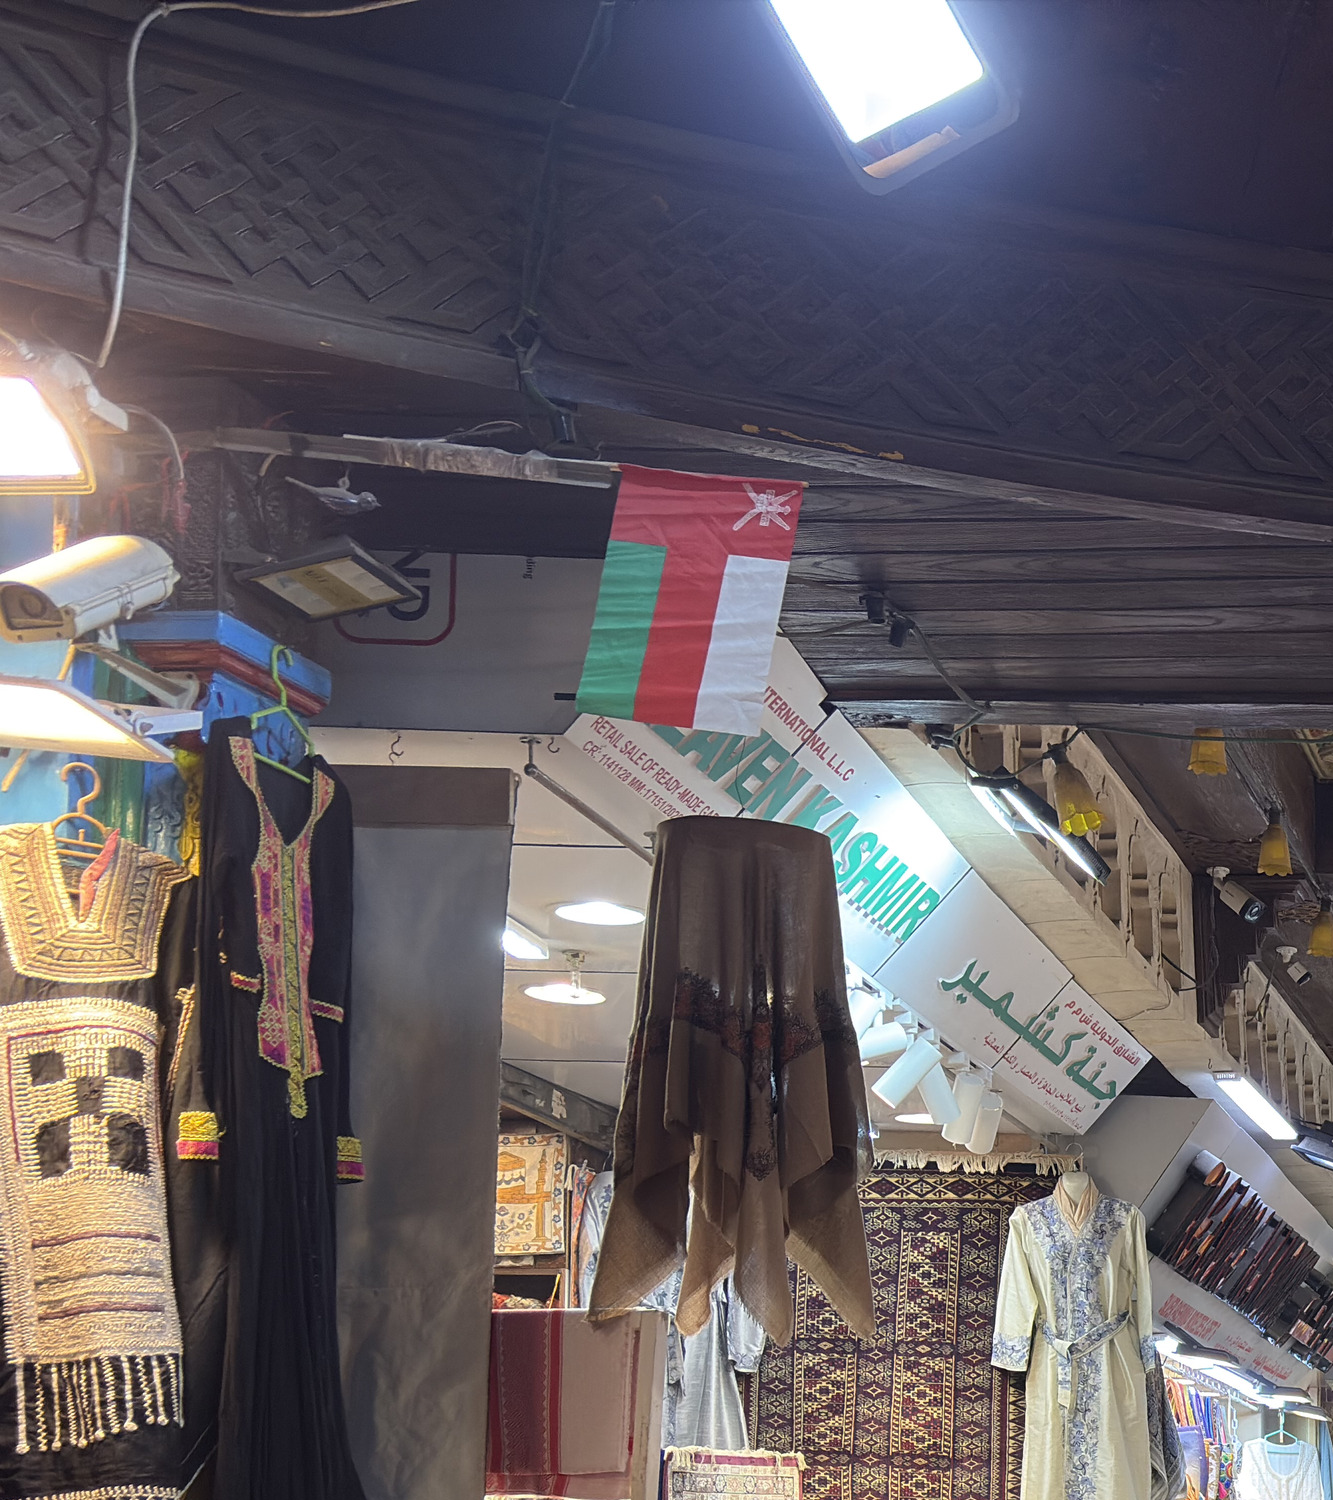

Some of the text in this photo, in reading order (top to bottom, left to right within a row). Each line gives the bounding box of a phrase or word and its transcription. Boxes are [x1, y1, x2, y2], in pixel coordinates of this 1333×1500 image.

[590, 716, 624, 749] RETAIL
[619, 740, 648, 766] SALE
[641, 758, 659, 775] OF
[651, 767, 705, 814] READY-MADE
[598, 754, 633, 782] 1141128
[763, 685, 855, 781] TERNATIONAL L.L.C
[790, 782, 941, 943] KASHMIR
[939, 958, 1117, 1110] جنة كشمير
[1090, 1021, 1120, 1047] الدولية
